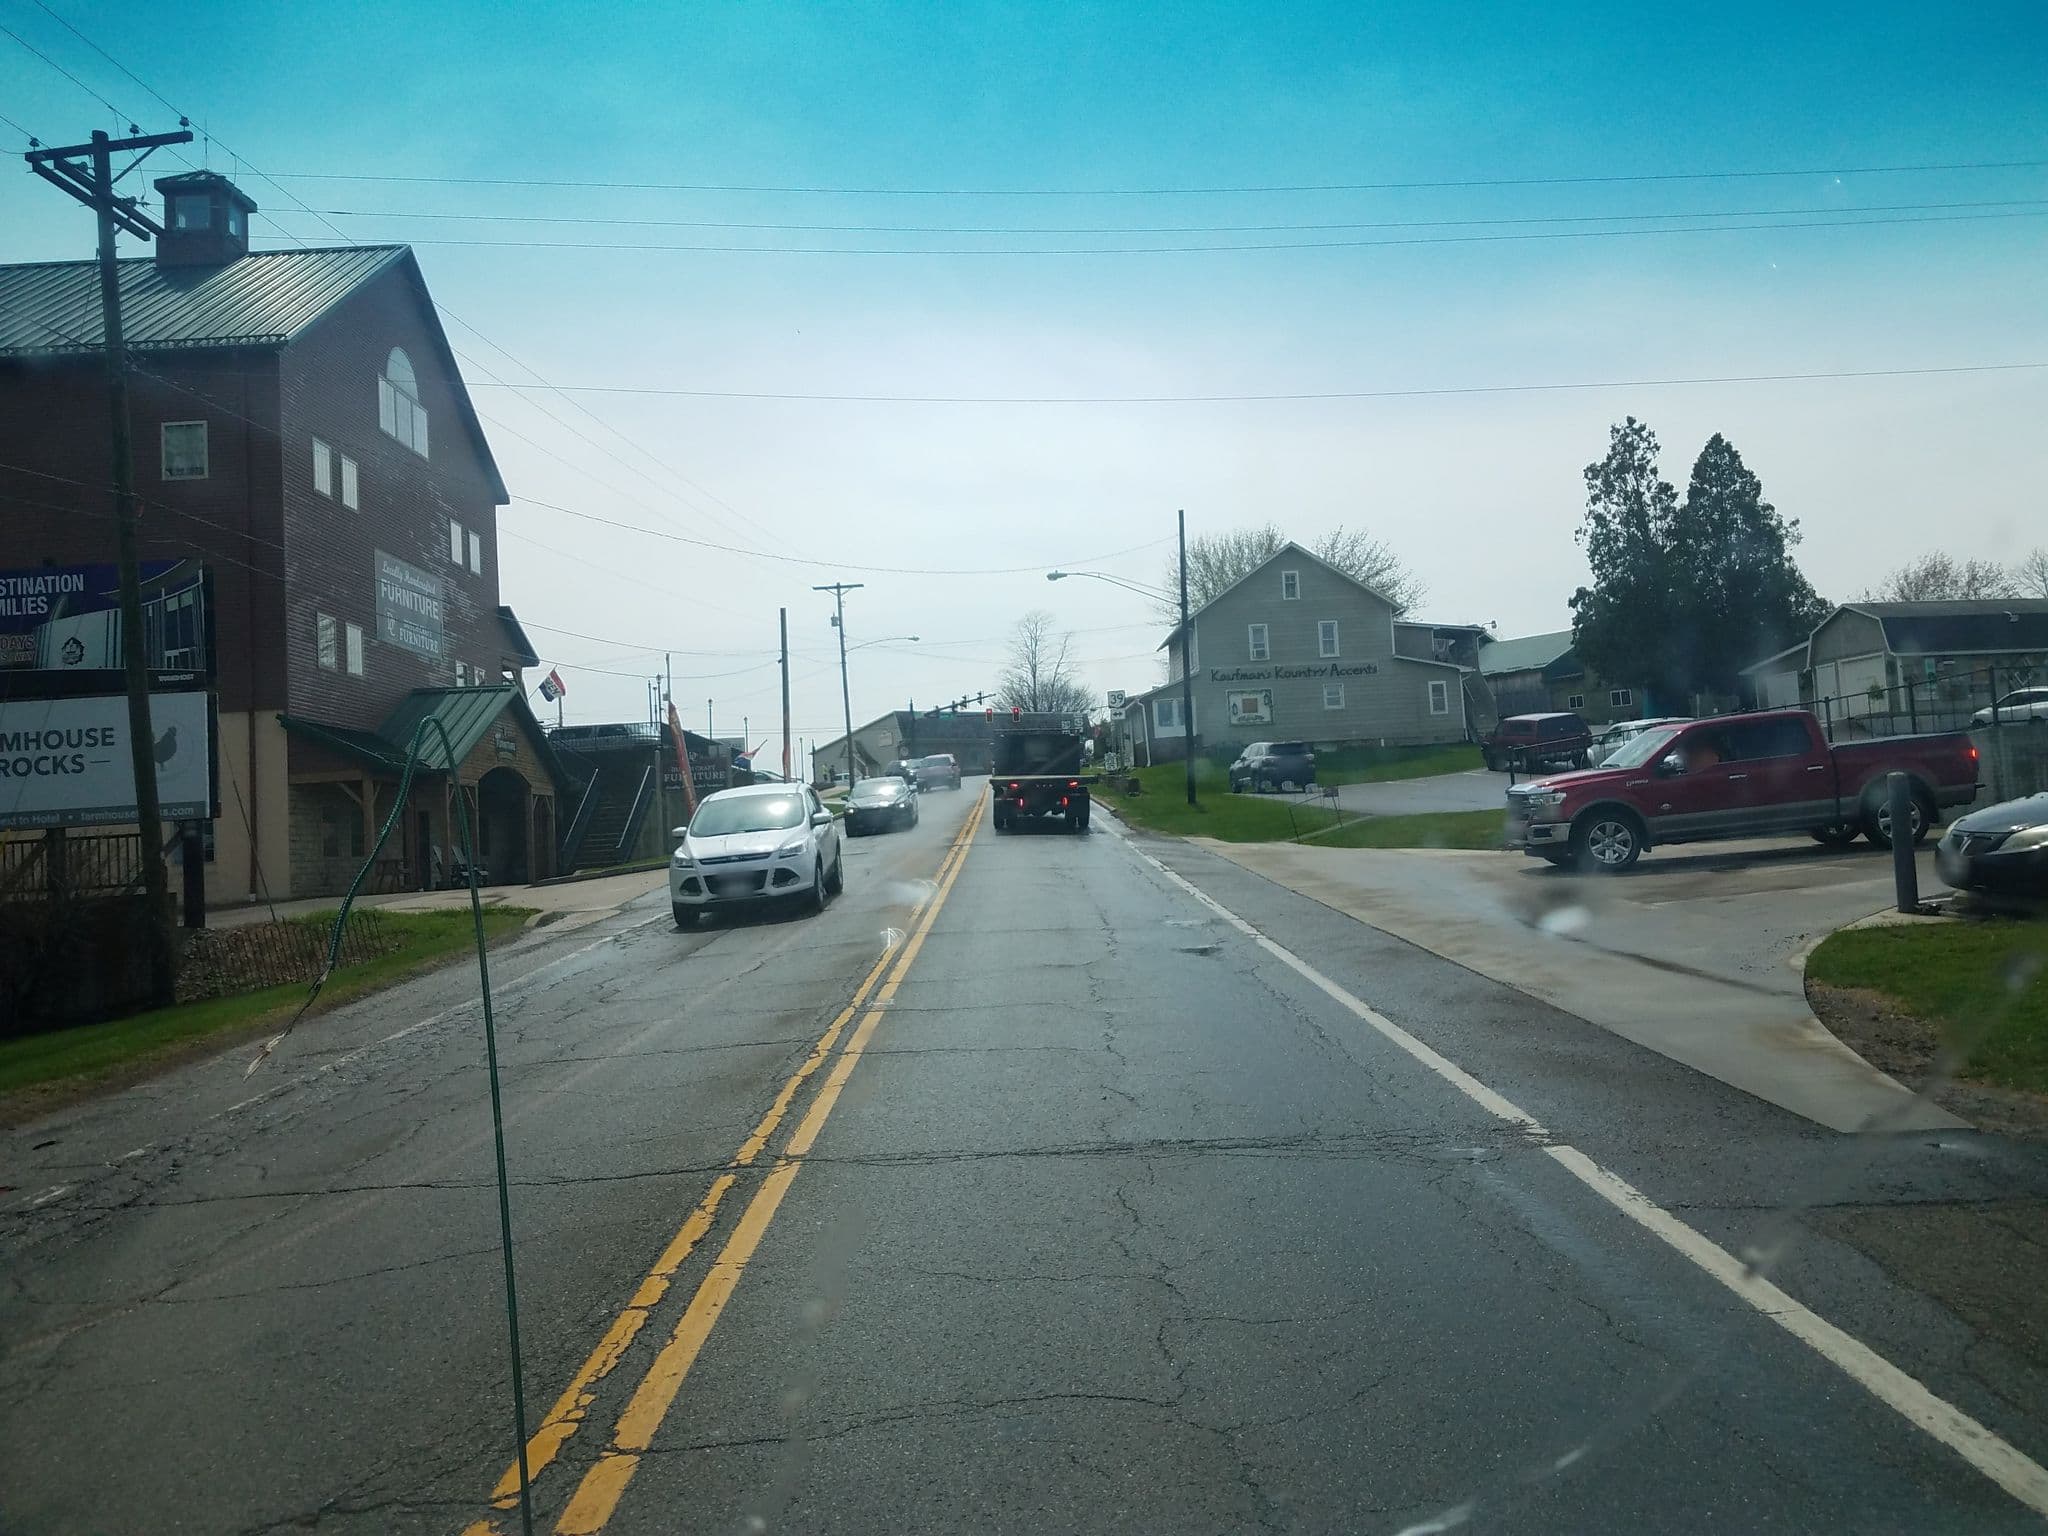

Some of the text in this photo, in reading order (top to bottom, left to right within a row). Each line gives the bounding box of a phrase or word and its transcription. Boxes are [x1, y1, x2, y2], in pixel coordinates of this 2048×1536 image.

[381, 578, 439, 620] FURNITURE
[399, 628, 439, 654] FURNITURE
[1274, 665, 1327, 680] Kountry
[1330, 663, 1378, 677] Accents
[1110, 693, 1124, 704] 39
[0, 728, 115, 752] MHOUSE
